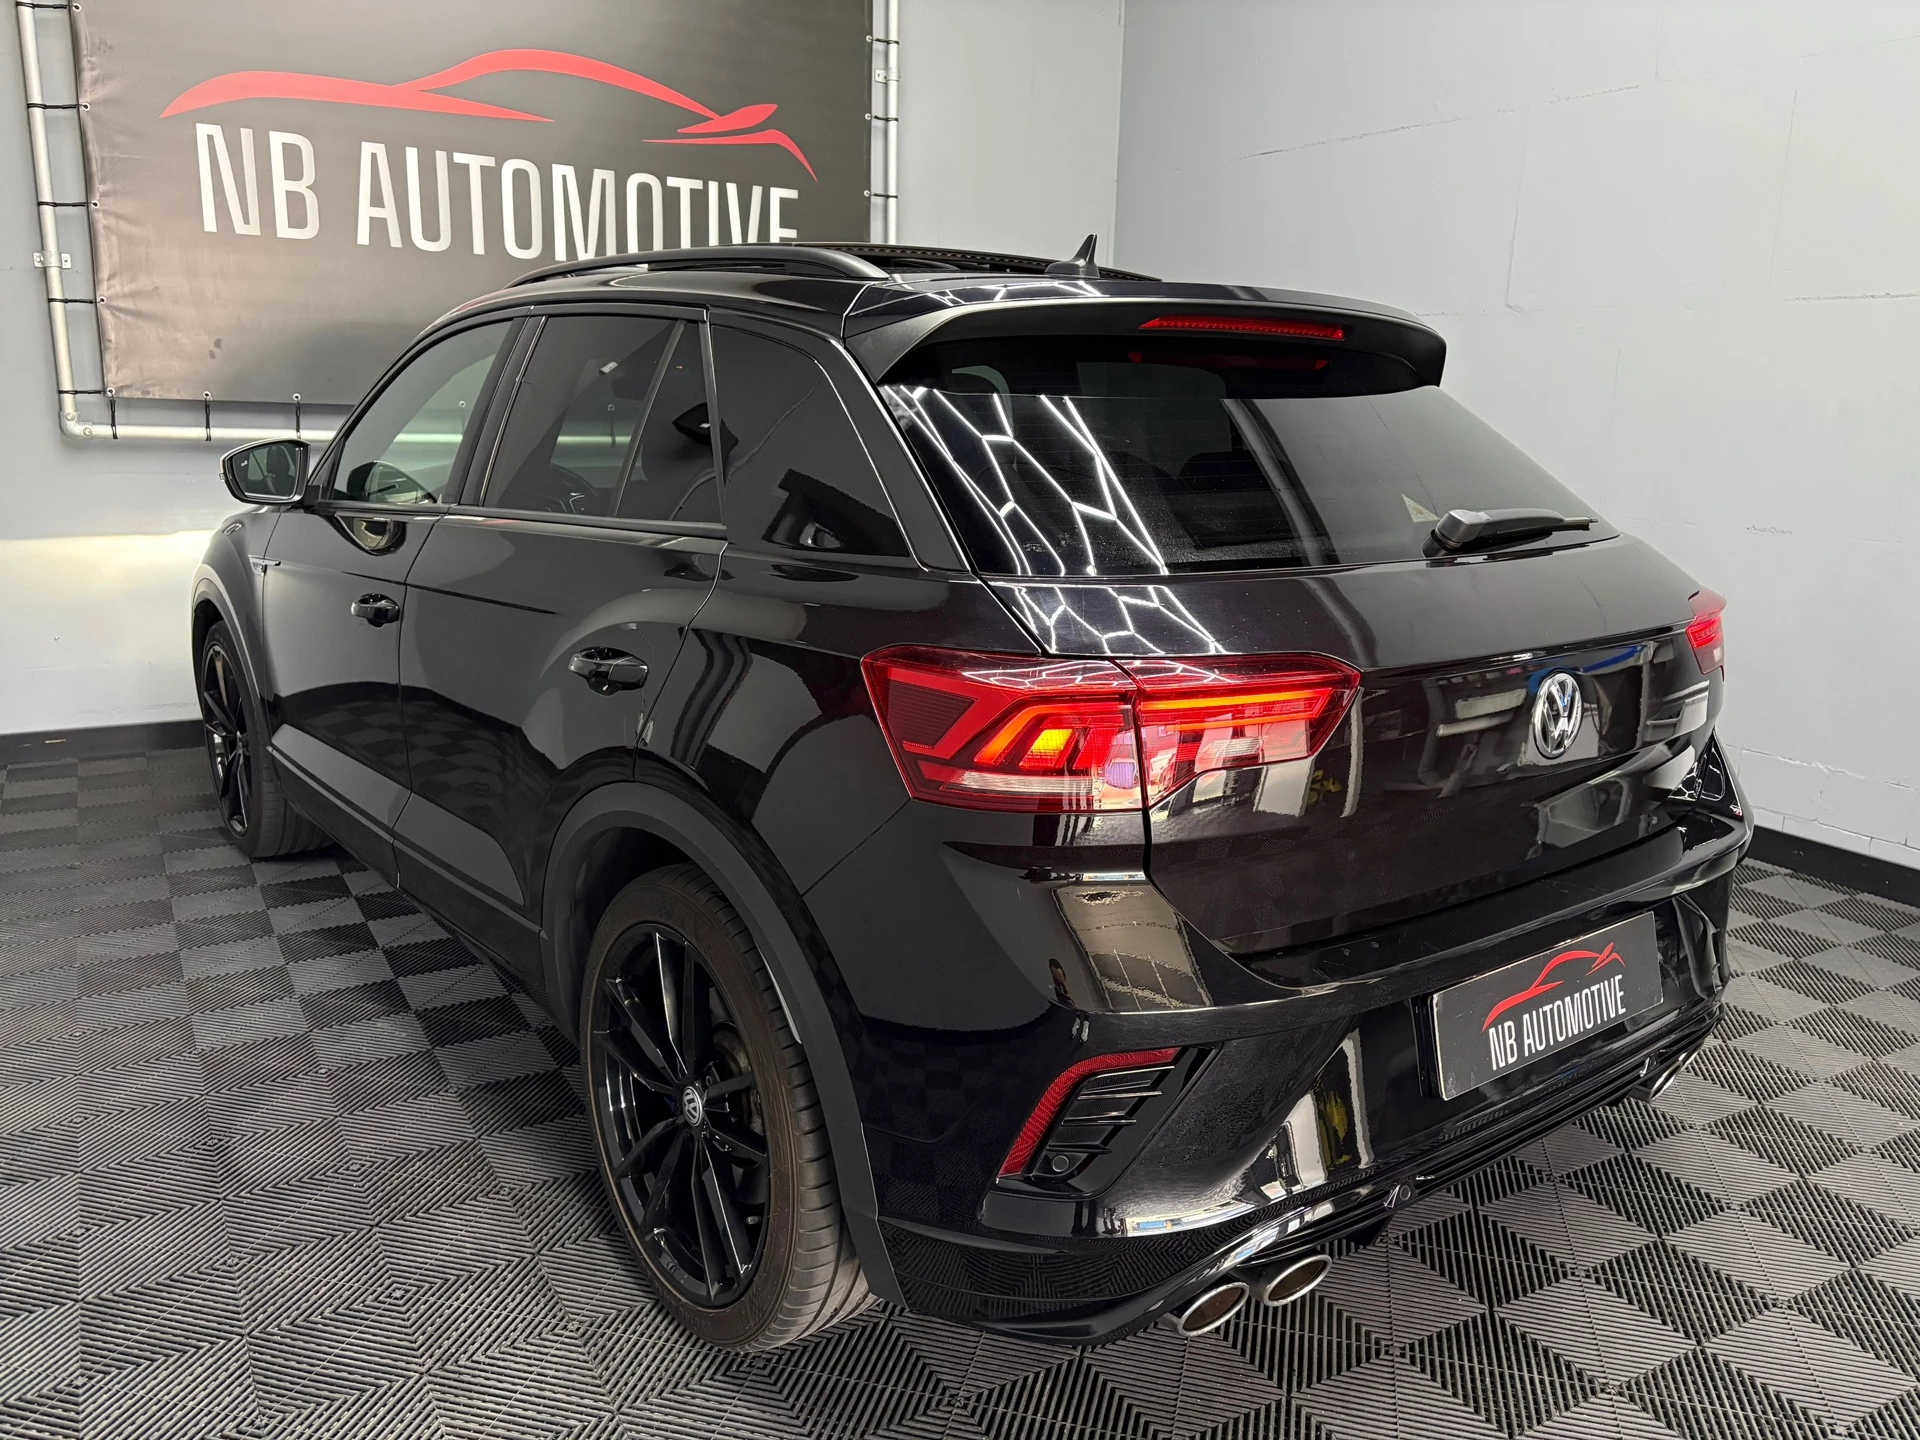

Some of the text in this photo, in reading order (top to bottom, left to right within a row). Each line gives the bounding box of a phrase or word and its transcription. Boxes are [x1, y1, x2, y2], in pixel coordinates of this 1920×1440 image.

[195, 122, 320, 240] NB
[1488, 974, 1627, 1071] NB AUTOMOTIVE
